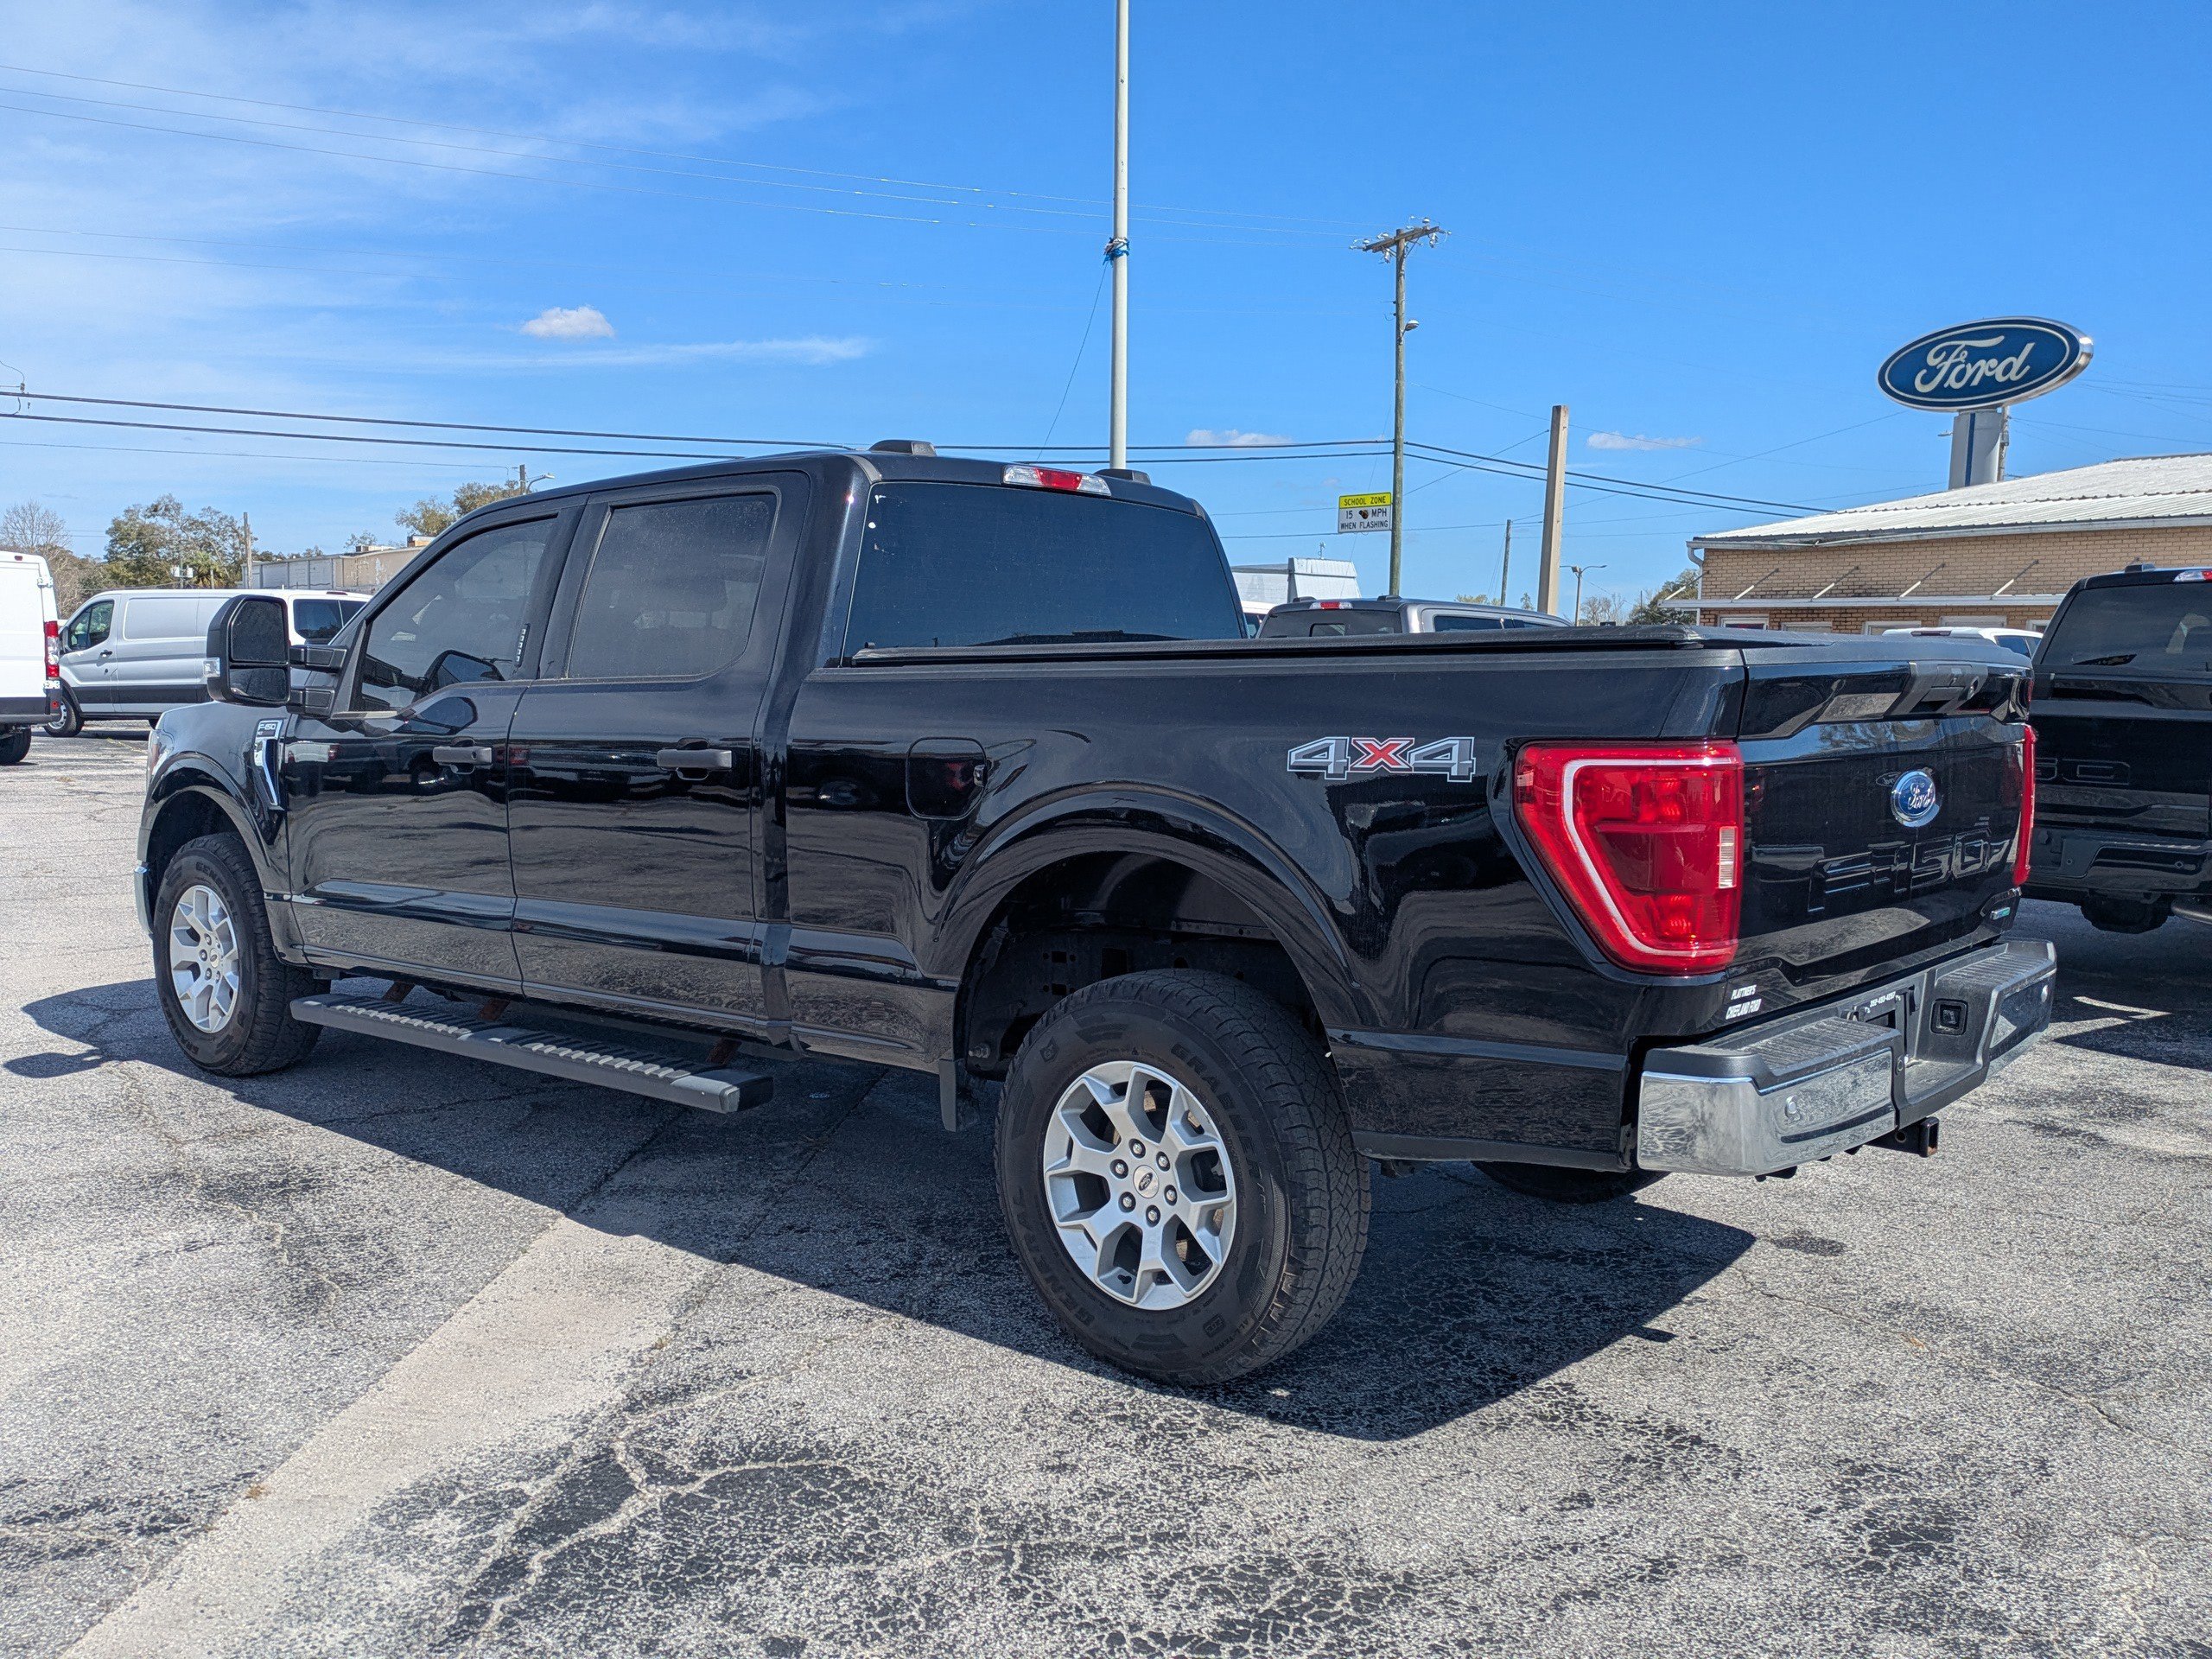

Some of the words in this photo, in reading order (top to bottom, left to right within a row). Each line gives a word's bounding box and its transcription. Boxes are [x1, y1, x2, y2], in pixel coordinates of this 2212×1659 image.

[1914, 335, 2036, 393] Ford
[1344, 498, 1367, 506] SCHOOL
[1370, 495, 1387, 505] ZONE
[1345, 510, 1354, 519] 15
[1371, 508, 1388, 518] MPH
[1359, 520, 1389, 529] FLASHING
[1908, 781, 1934, 810] Ford
[1171, 1043, 1262, 1180] GRABBER
